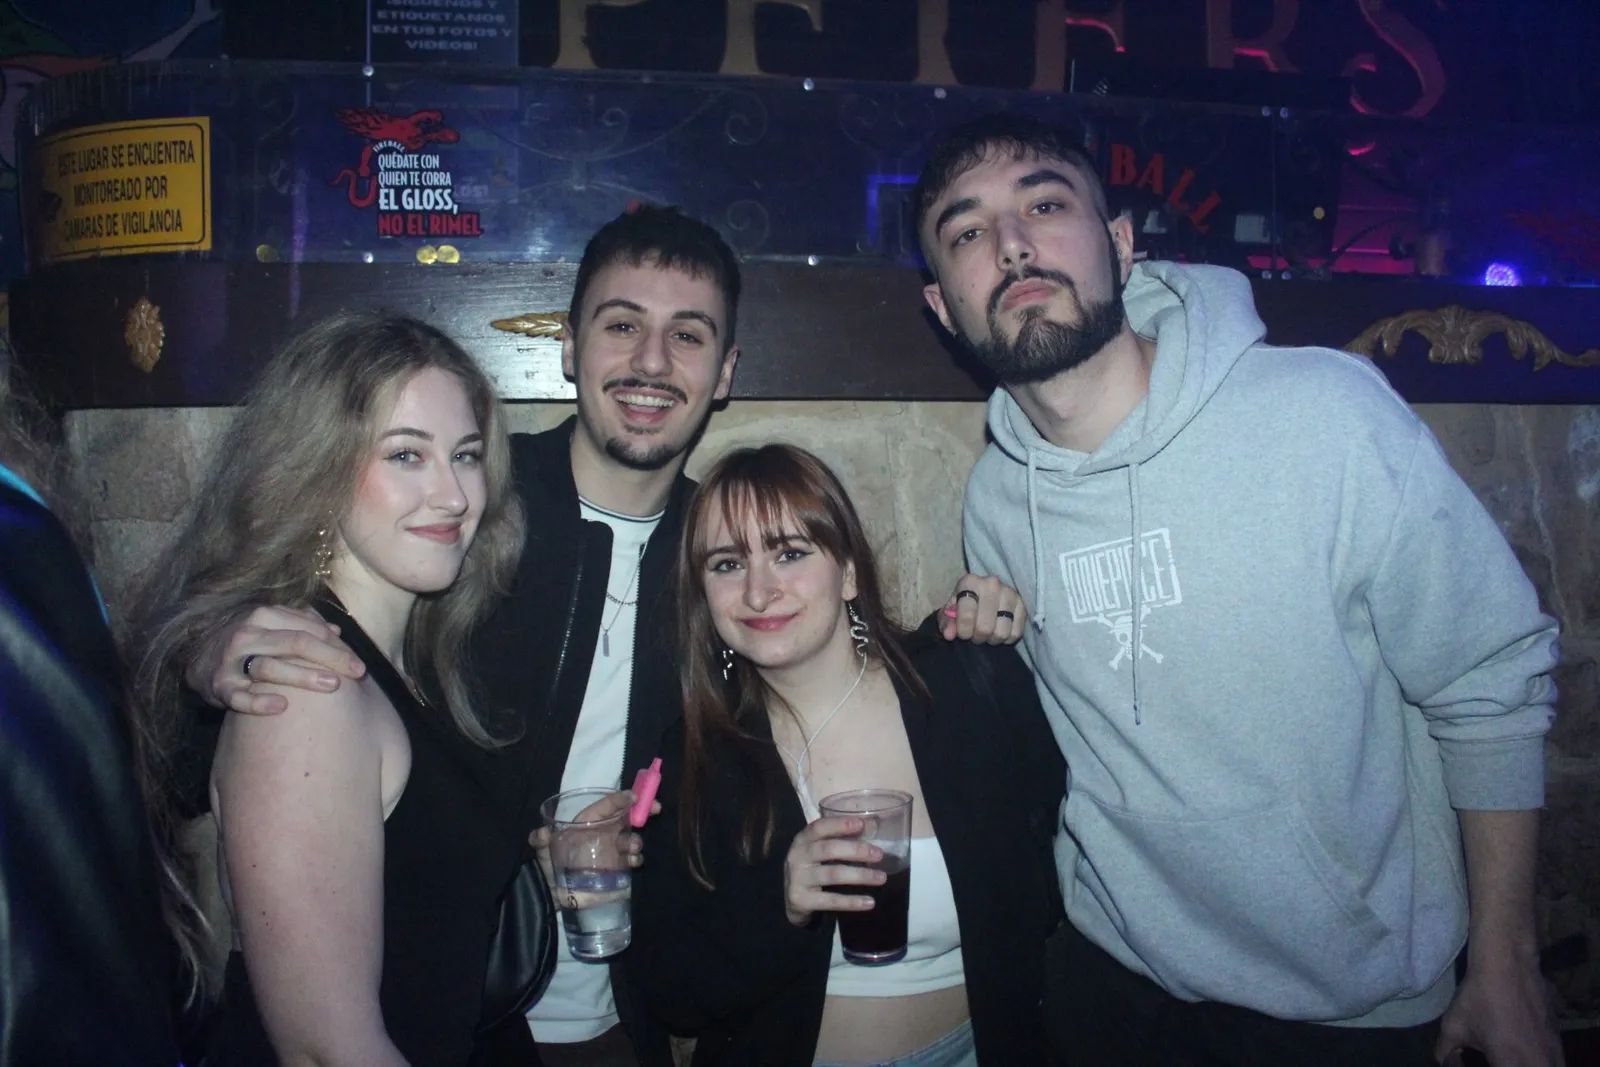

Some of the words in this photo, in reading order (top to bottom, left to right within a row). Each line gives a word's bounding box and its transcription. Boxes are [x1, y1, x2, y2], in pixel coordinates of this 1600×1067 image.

[371, 24, 399, 34] EN
[401, 25, 436, 36] TUS
[439, 26, 497, 38] FOTOS
[501, 28, 513, 38] Y
[58, 152, 78, 177] ESTE
[79, 145, 109, 172] LUGAR
[111, 144, 125, 168] SE
[127, 140, 196, 167] ENCUENTRA
[378, 151, 420, 171] QUÉDATE
[420, 154, 440, 169] CON
[73, 176, 142, 207] MONITOREADO
[145, 175, 168, 200] POR
[378, 171, 408, 188] QUIEN
[409, 171, 420, 186] TE
[421, 171, 452, 186] CORRA
[379, 188, 399, 211] EL
[401, 188, 459, 215] GLOSS,
[64, 214, 103, 242] CAMARAS
[105, 212, 119, 236] DE
[121, 209, 183, 235] VIGILANCIA
[379, 213, 403, 236] NO
[406, 213, 426, 236] EL
